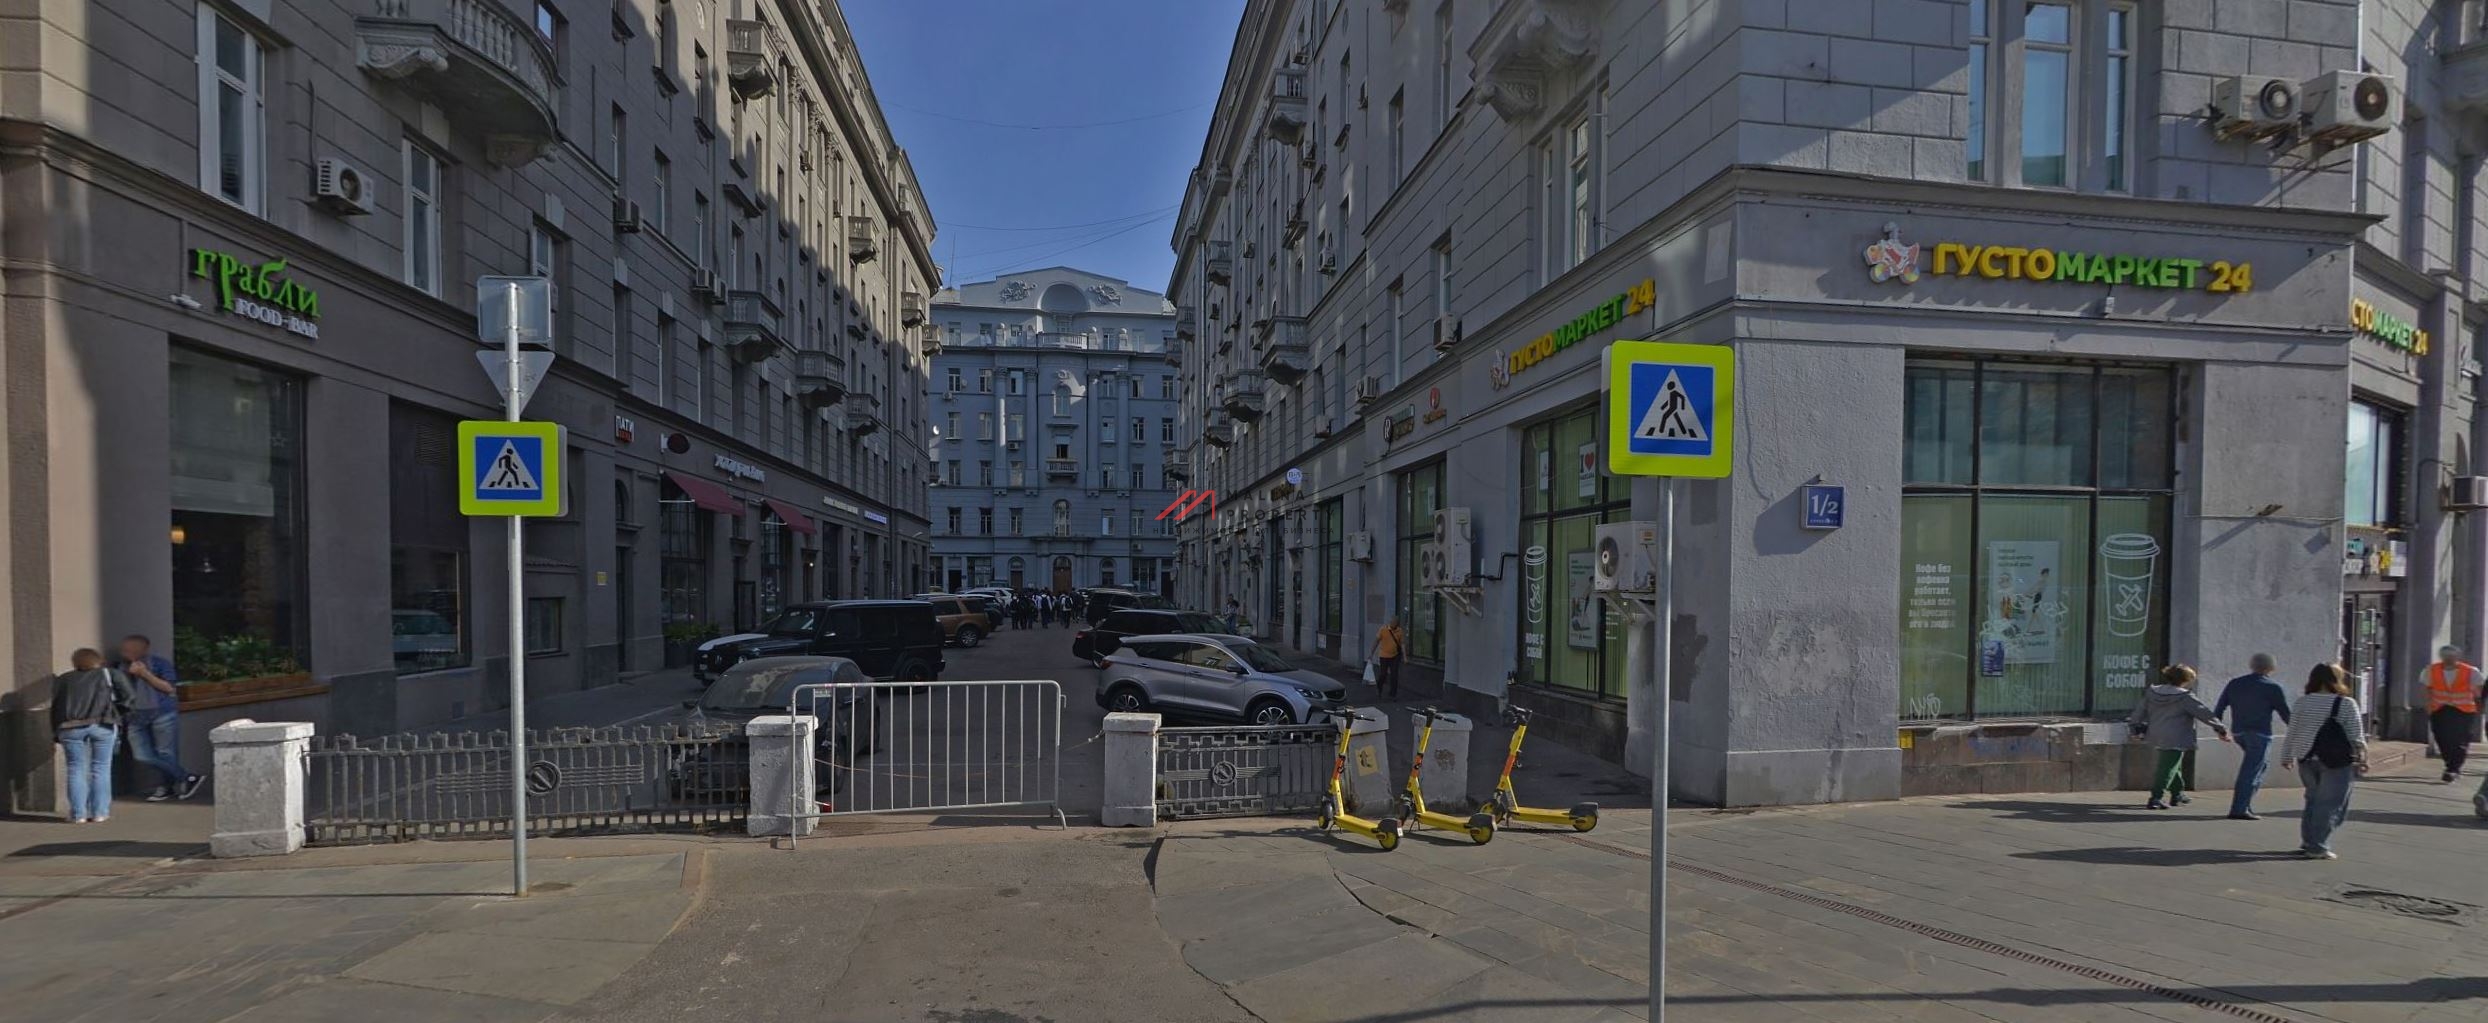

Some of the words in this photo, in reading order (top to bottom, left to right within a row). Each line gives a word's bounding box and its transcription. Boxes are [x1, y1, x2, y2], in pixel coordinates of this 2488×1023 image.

[1932, 242, 2203, 290] ГУСТОМАРКЕТ
[2206, 260, 2253, 293] 24
[1509, 293, 1628, 376] ГУСТОМАРКЕТ
[1627, 278, 1656, 316] 24
[2351, 298, 2413, 351] СТОМАРКЕТ
[1811, 494, 1839, 517] 1/2
[2103, 654, 2140, 669] КОФЕ
[2141, 654, 2150, 669] С
[2106, 671, 2147, 688] СОБОЙ
